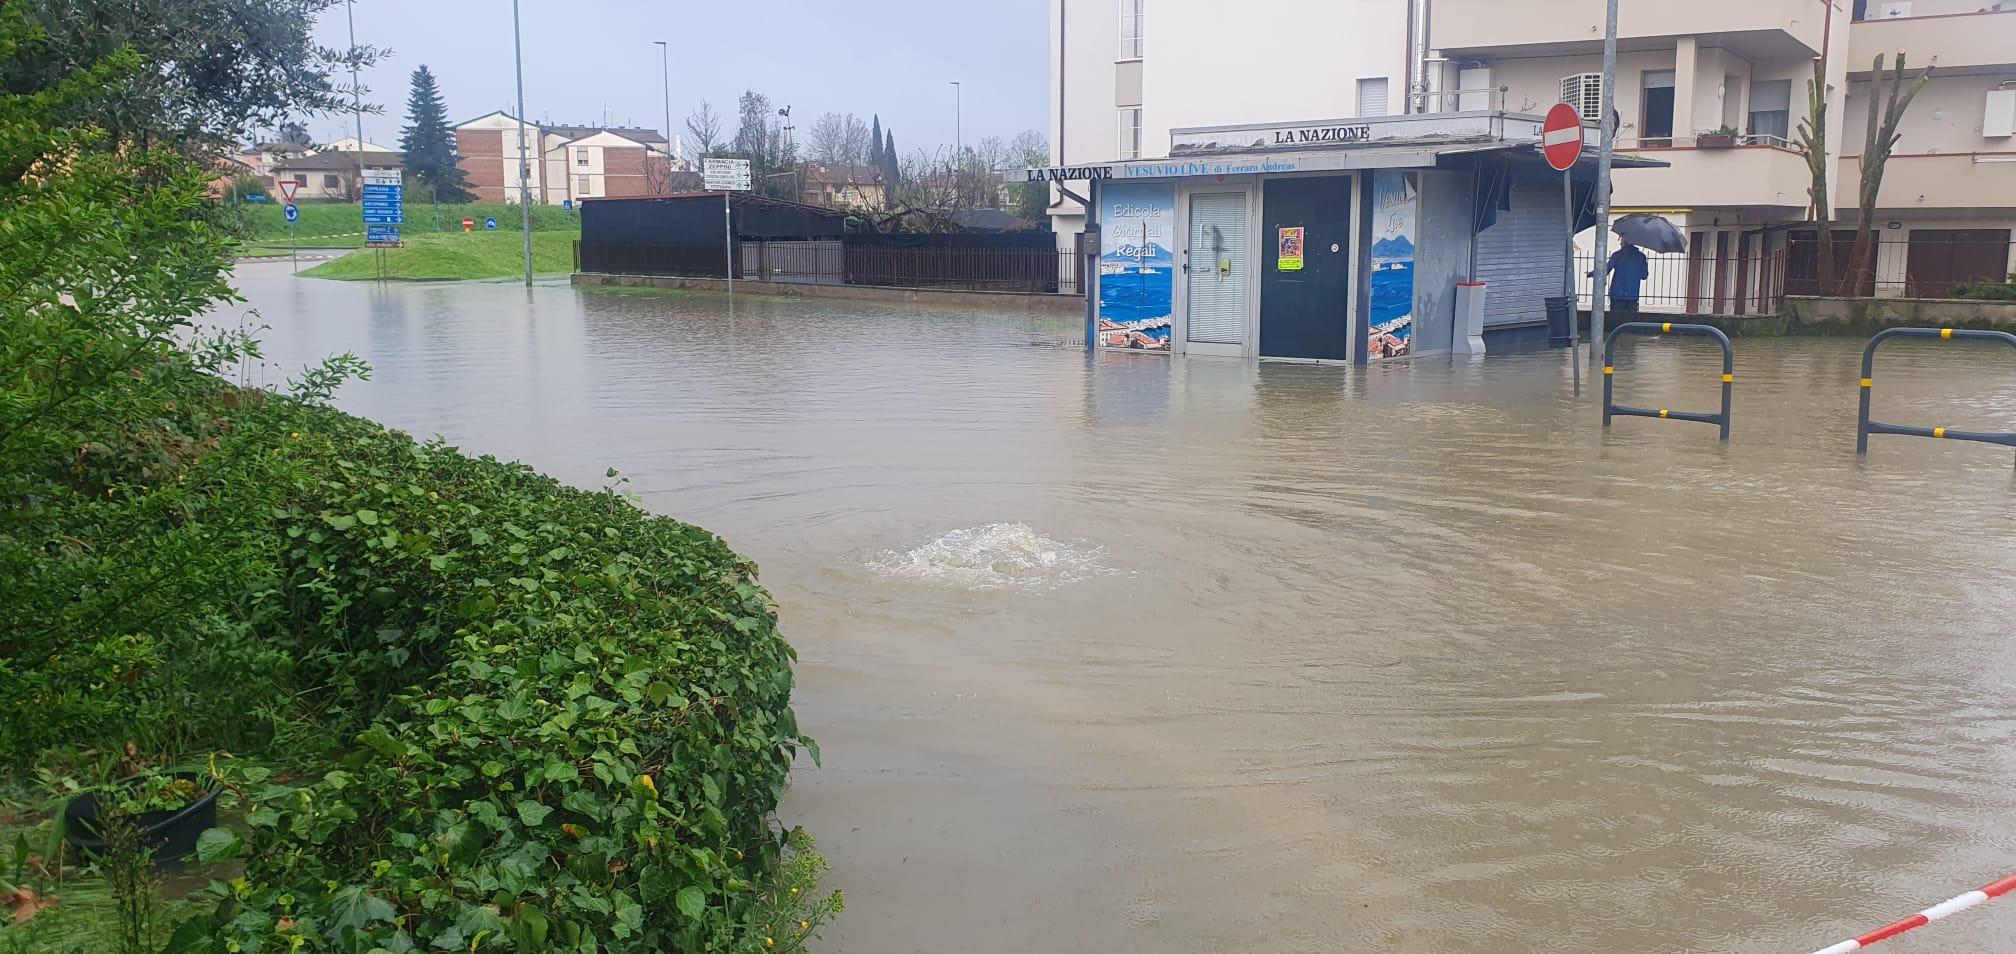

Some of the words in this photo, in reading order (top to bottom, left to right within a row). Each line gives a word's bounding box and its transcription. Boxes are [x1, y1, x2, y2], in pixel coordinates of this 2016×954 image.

[1274, 130, 1295, 144] LA
[1299, 126, 1370, 142] NAZIONE
[1026, 169, 1046, 182] LA
[1048, 166, 1113, 181] NAZIONE
[1127, 163, 1178, 177] VESUVIO
[1181, 163, 1209, 176] LIVE
[1214, 166, 1222, 174] di
[1226, 164, 1258, 173] Ferraro
[1113, 203, 1161, 218] Edicola
[1112, 223, 1161, 238] Giornali
[1116, 243, 1156, 261] Regali
